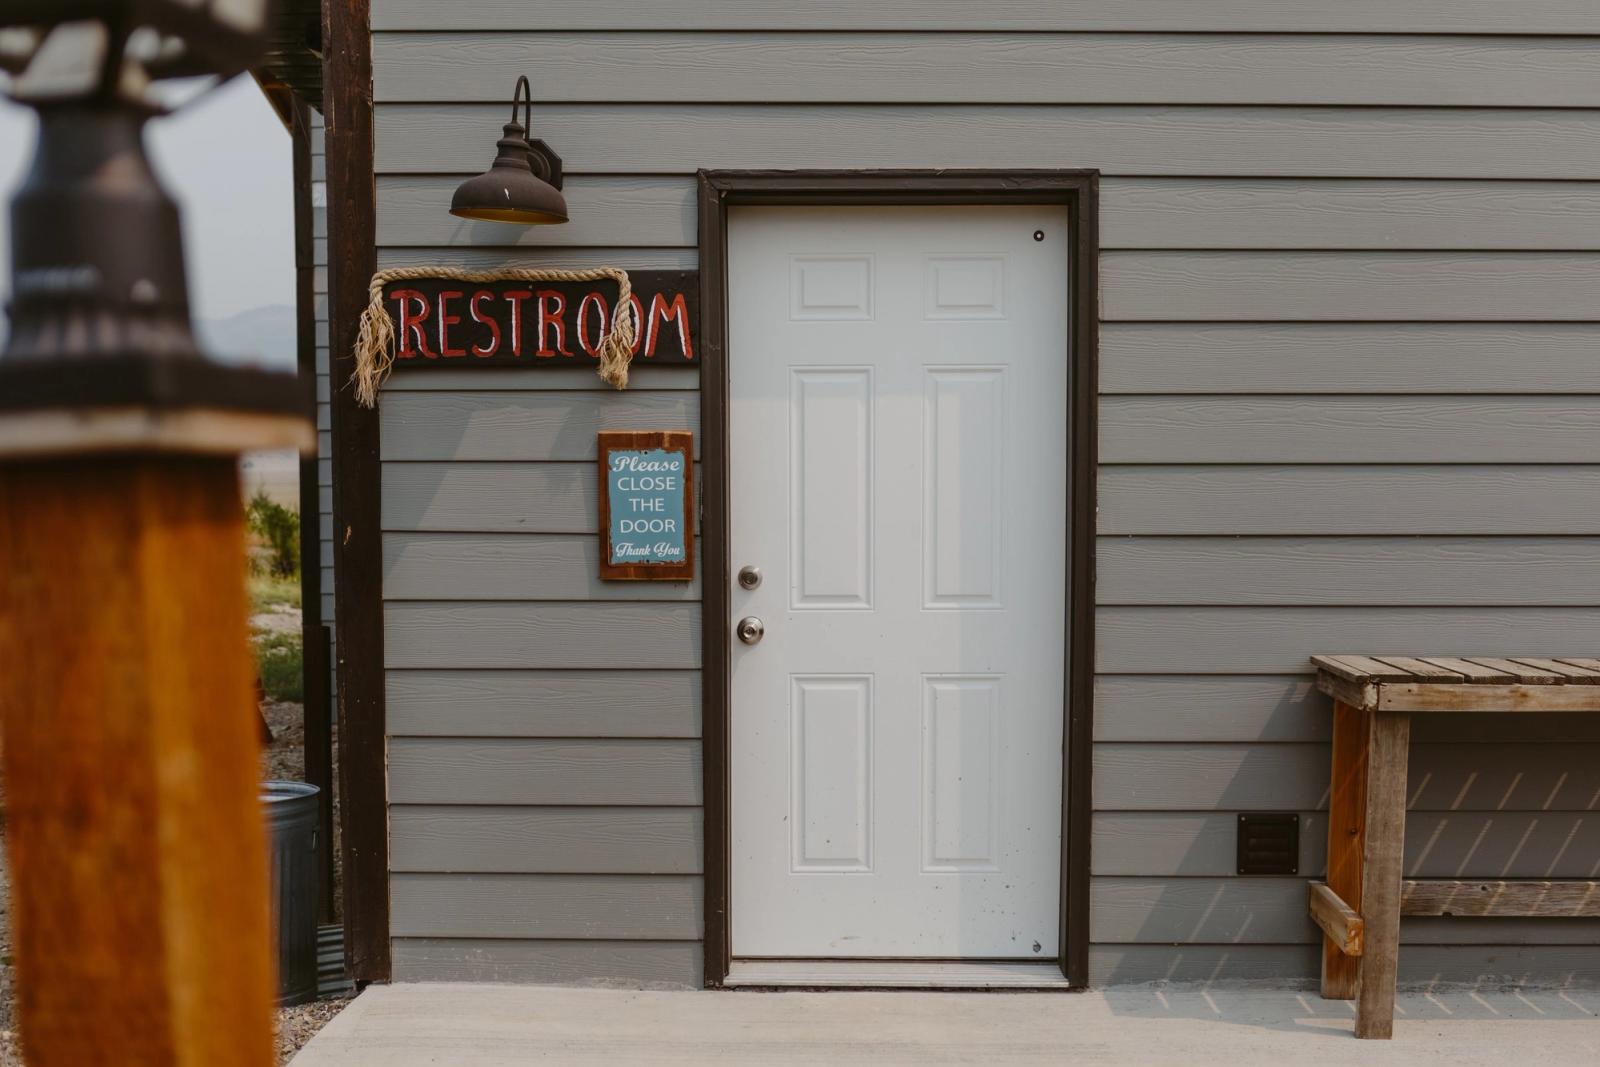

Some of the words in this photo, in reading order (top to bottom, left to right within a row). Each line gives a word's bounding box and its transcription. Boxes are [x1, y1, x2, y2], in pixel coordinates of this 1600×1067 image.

[613, 456, 680, 472] Please
[617, 477, 676, 491] CLOSE
[628, 498, 665, 512] THE
[620, 519, 676, 533] DOOR
[615, 542, 651, 557] Thank
[653, 541, 681, 557] You
